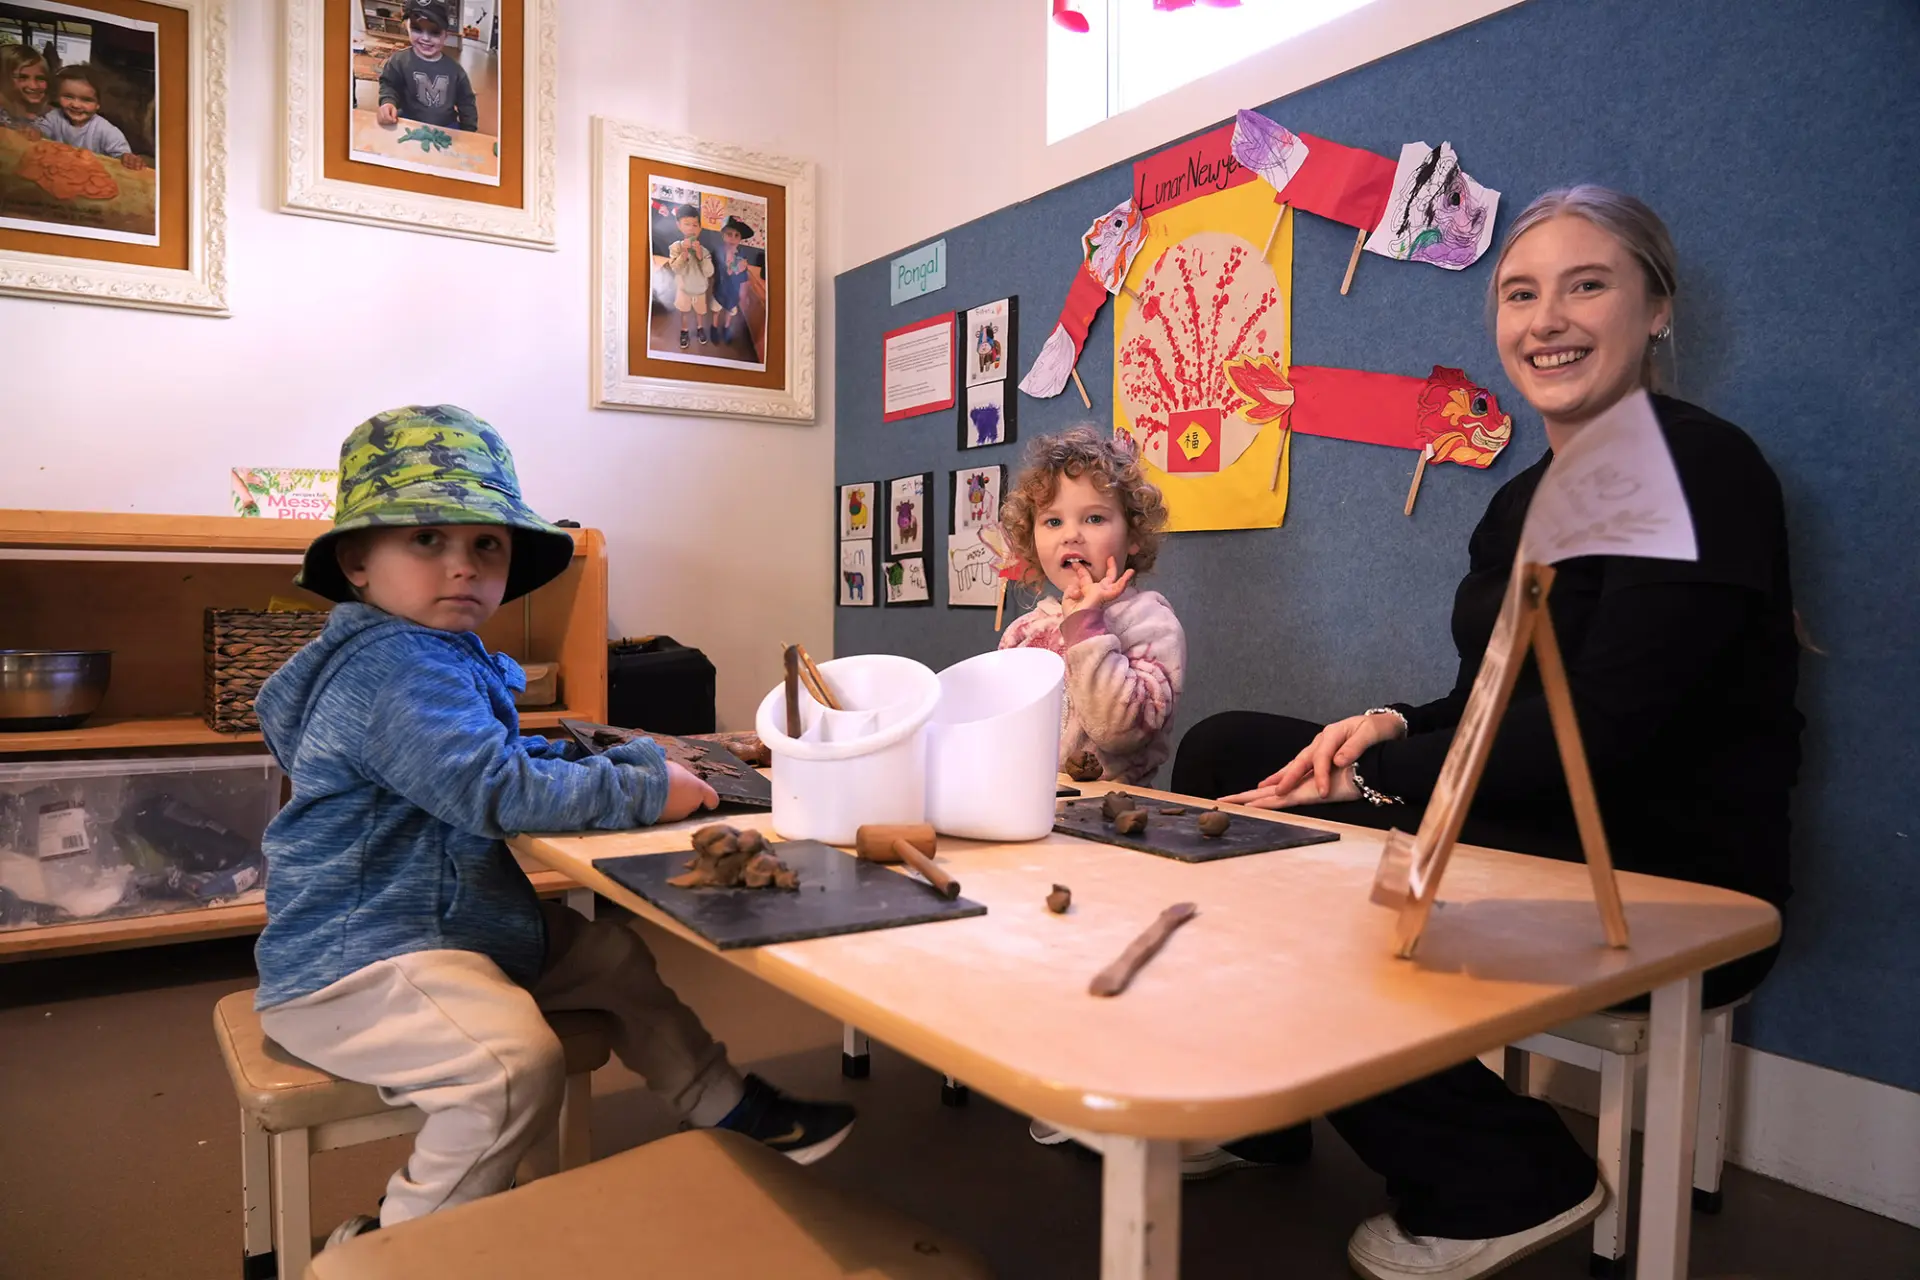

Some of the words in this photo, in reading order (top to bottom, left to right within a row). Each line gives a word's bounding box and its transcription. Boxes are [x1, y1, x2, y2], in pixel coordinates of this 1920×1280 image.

[413, 71, 449, 107] M
[1139, 173, 1185, 211] Lunar
[898, 247, 938, 291] Pongal
[1184, 431, 1199, 449] 福
[268, 495, 332, 513] Messy
